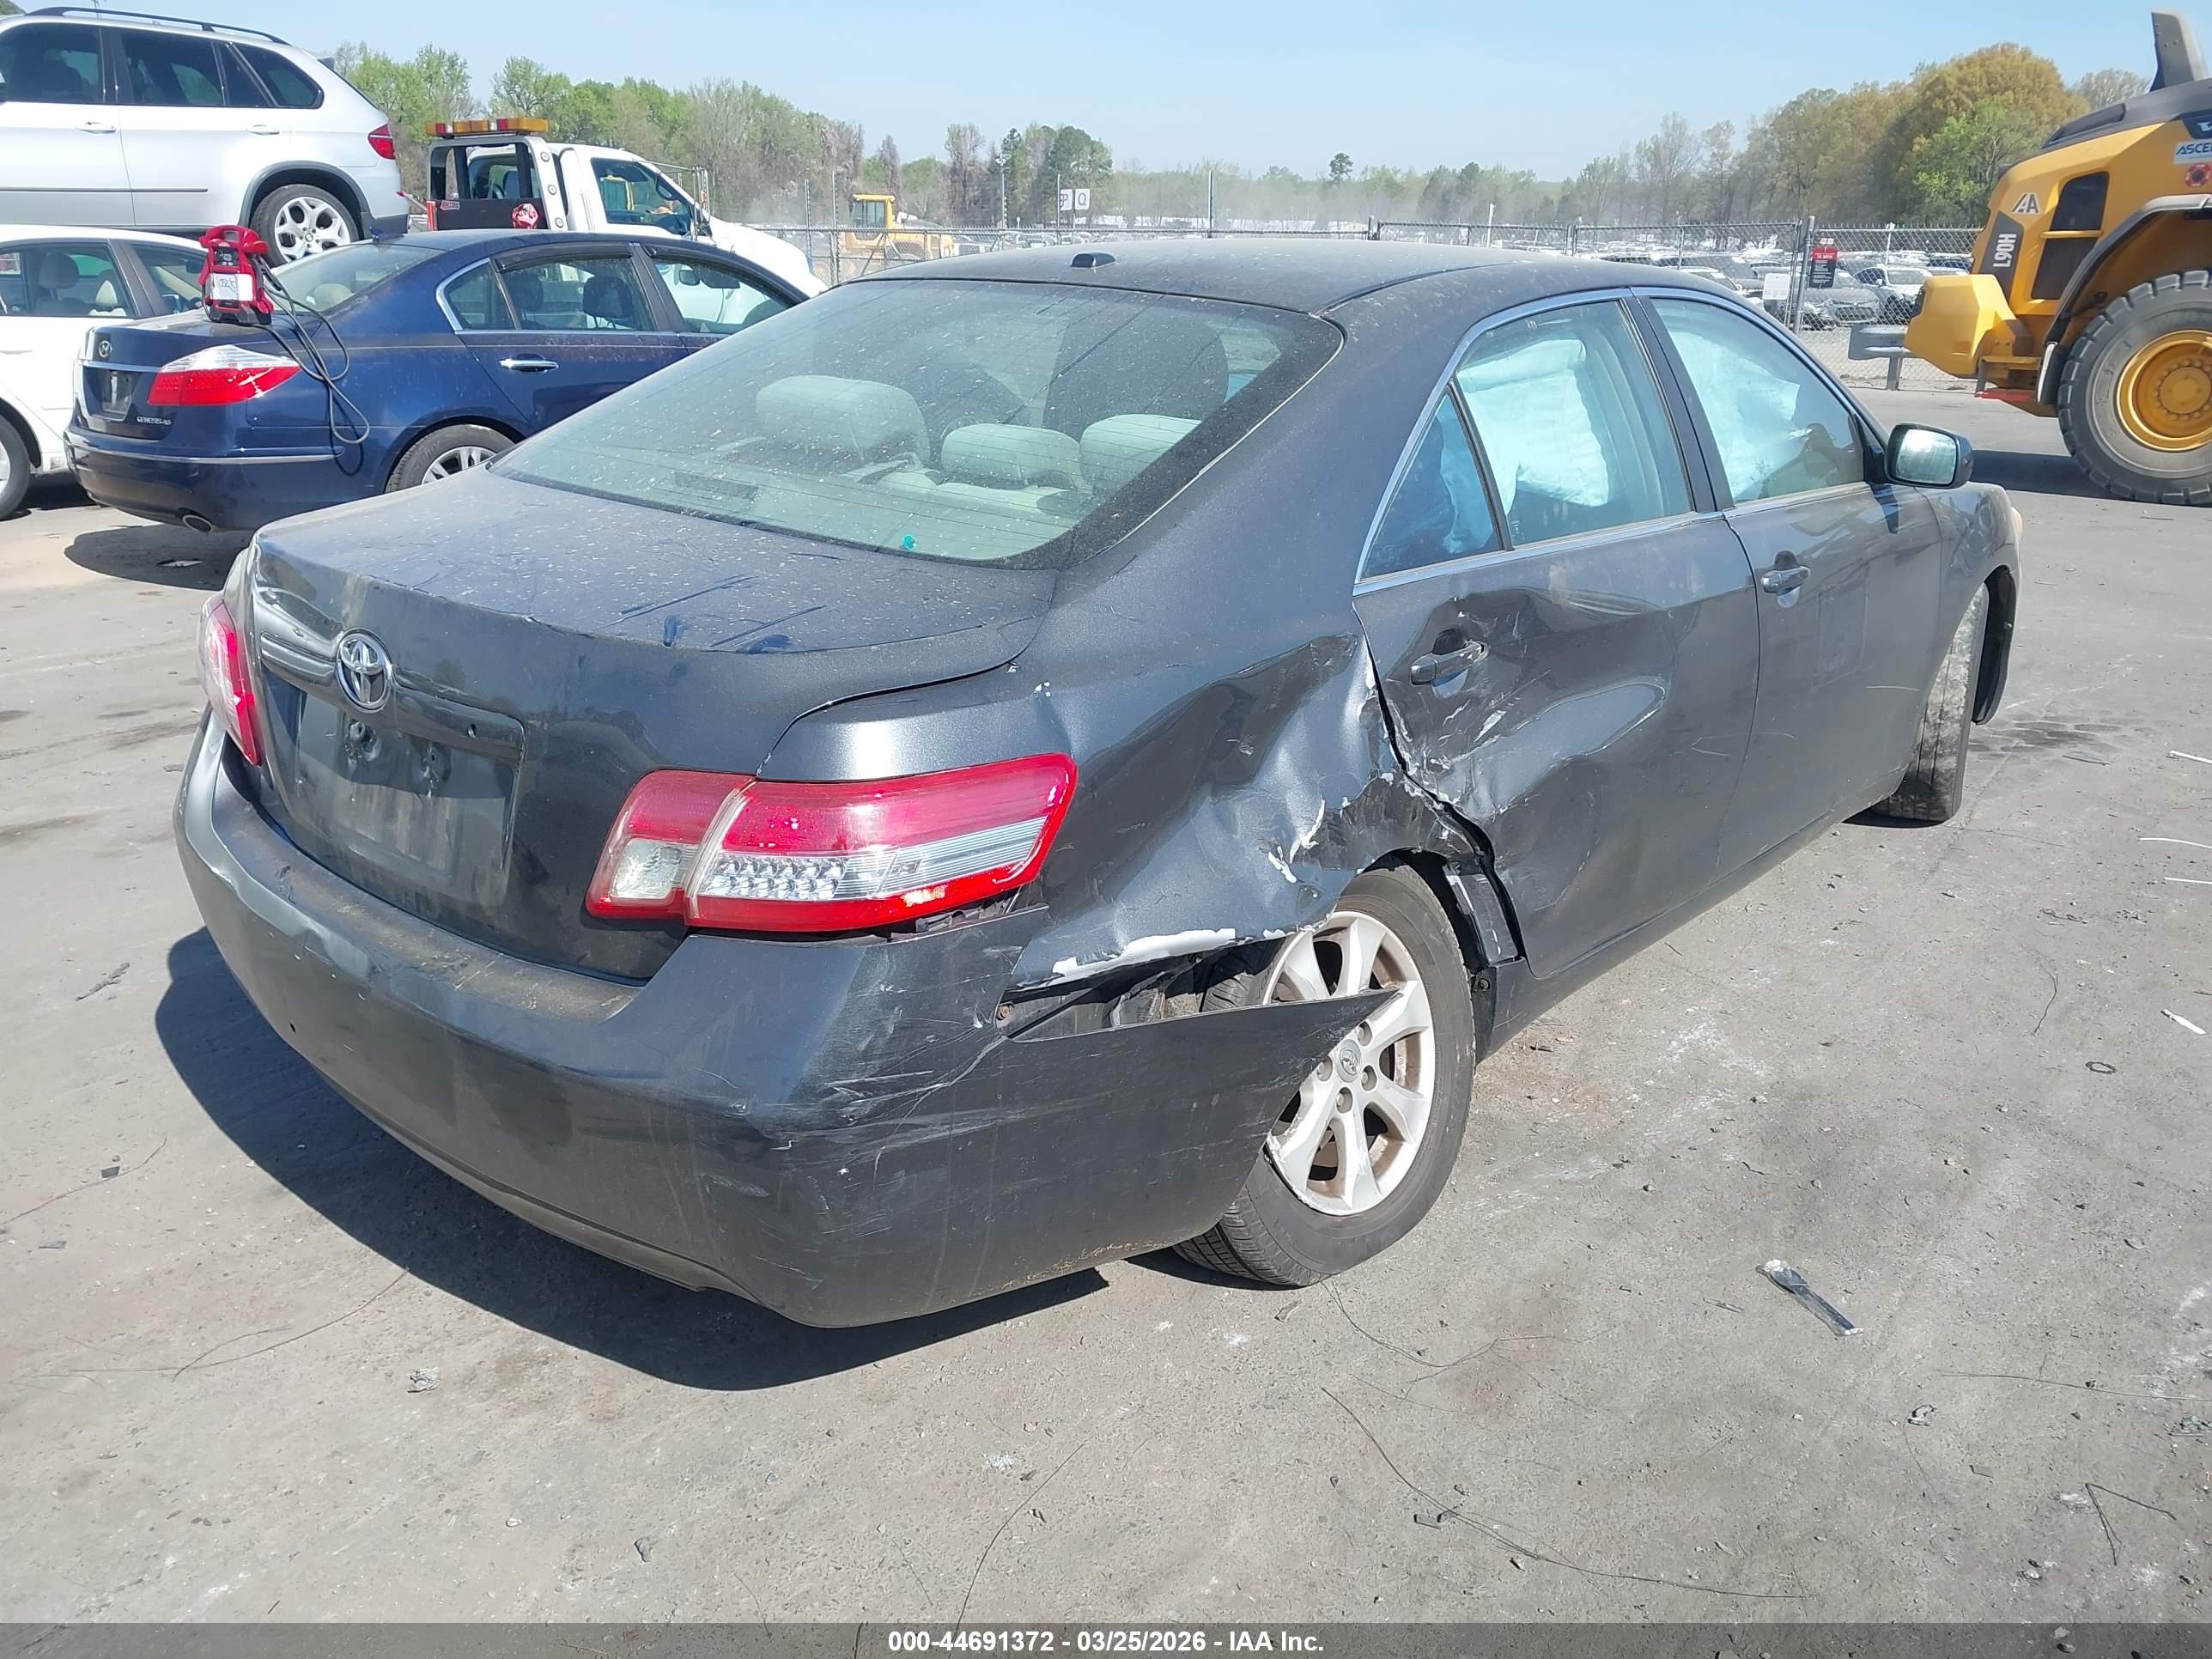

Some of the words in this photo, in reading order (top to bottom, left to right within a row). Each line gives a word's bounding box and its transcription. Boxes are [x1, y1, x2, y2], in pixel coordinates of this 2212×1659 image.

[2175, 143, 2212, 155] ASCE
[1078, 191, 1087, 206] Q
[1992, 233, 2017, 268] L90H
